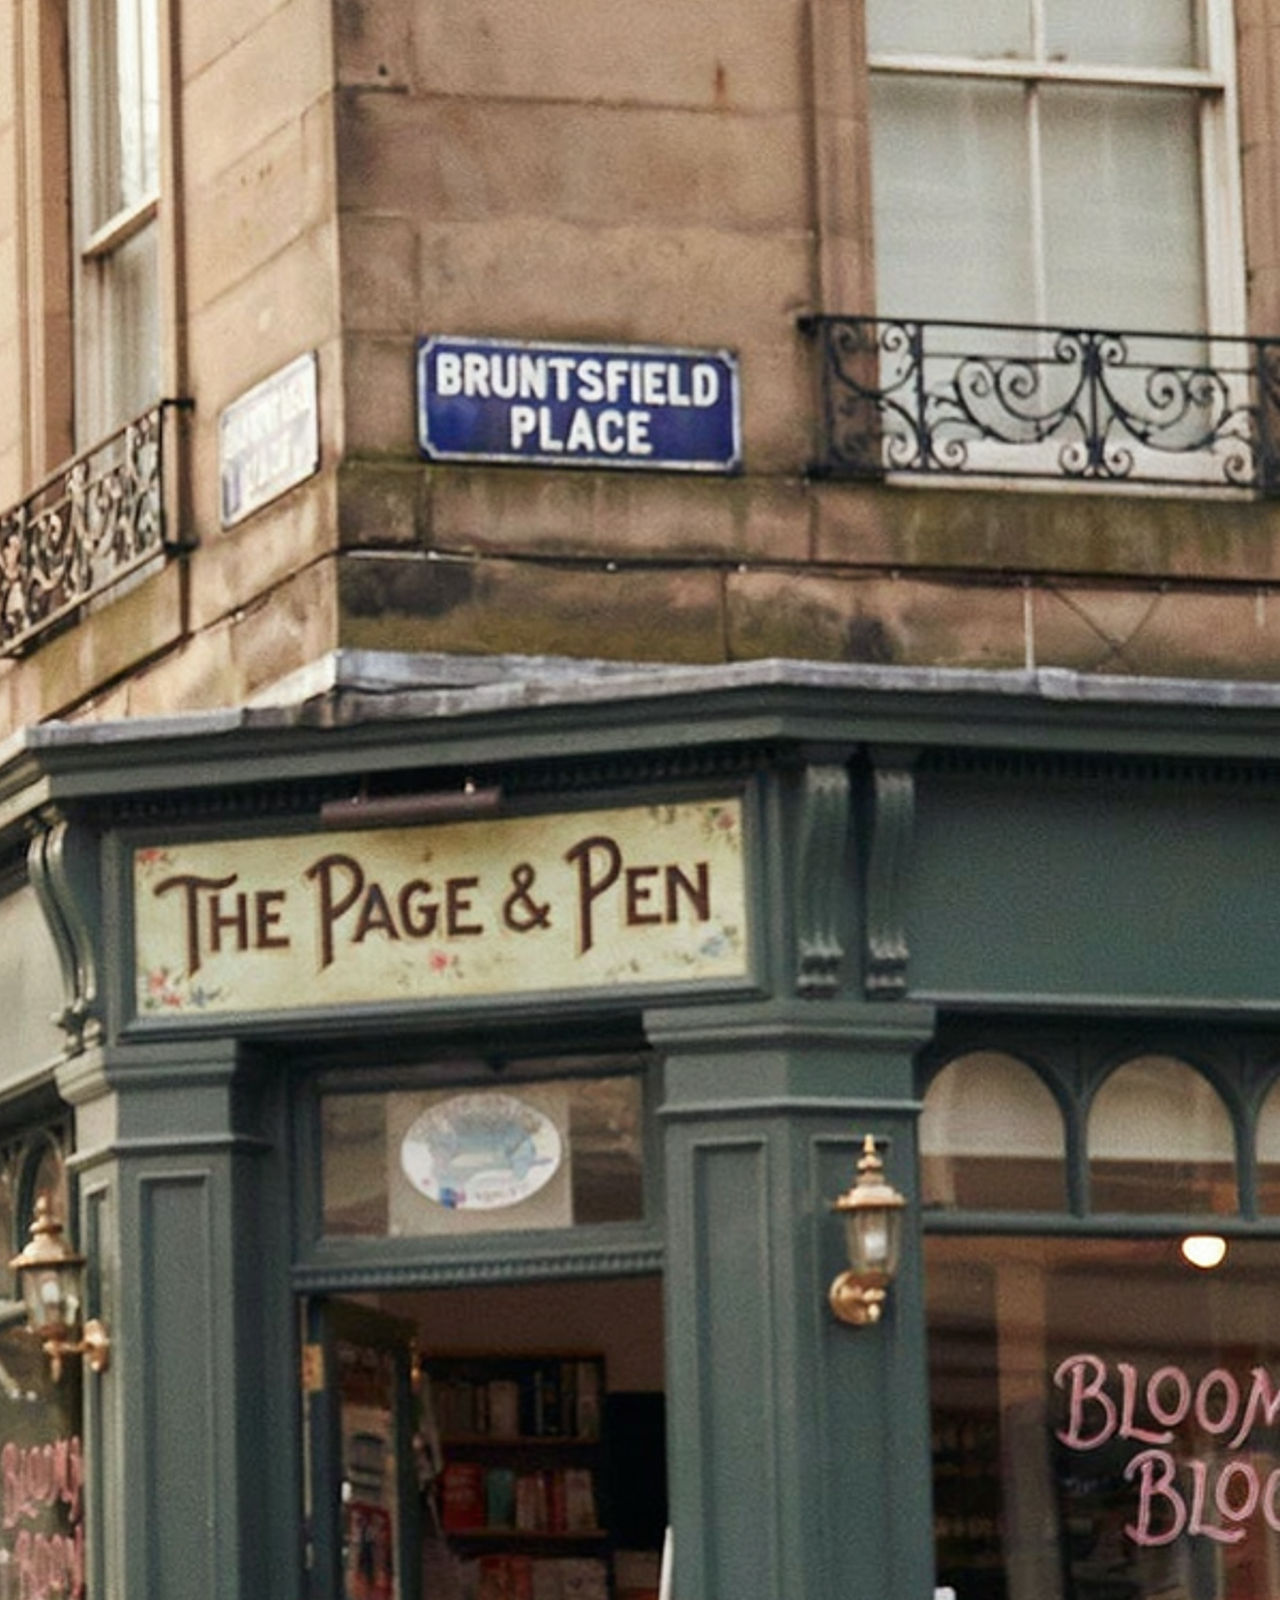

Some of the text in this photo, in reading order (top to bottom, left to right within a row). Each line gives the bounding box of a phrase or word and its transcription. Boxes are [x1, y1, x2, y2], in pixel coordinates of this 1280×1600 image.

[436, 353, 719, 407] BRUNTSFIELD
[510, 405, 653, 454] PLACE
[153, 835, 712, 977] THE PAGE & PEN
